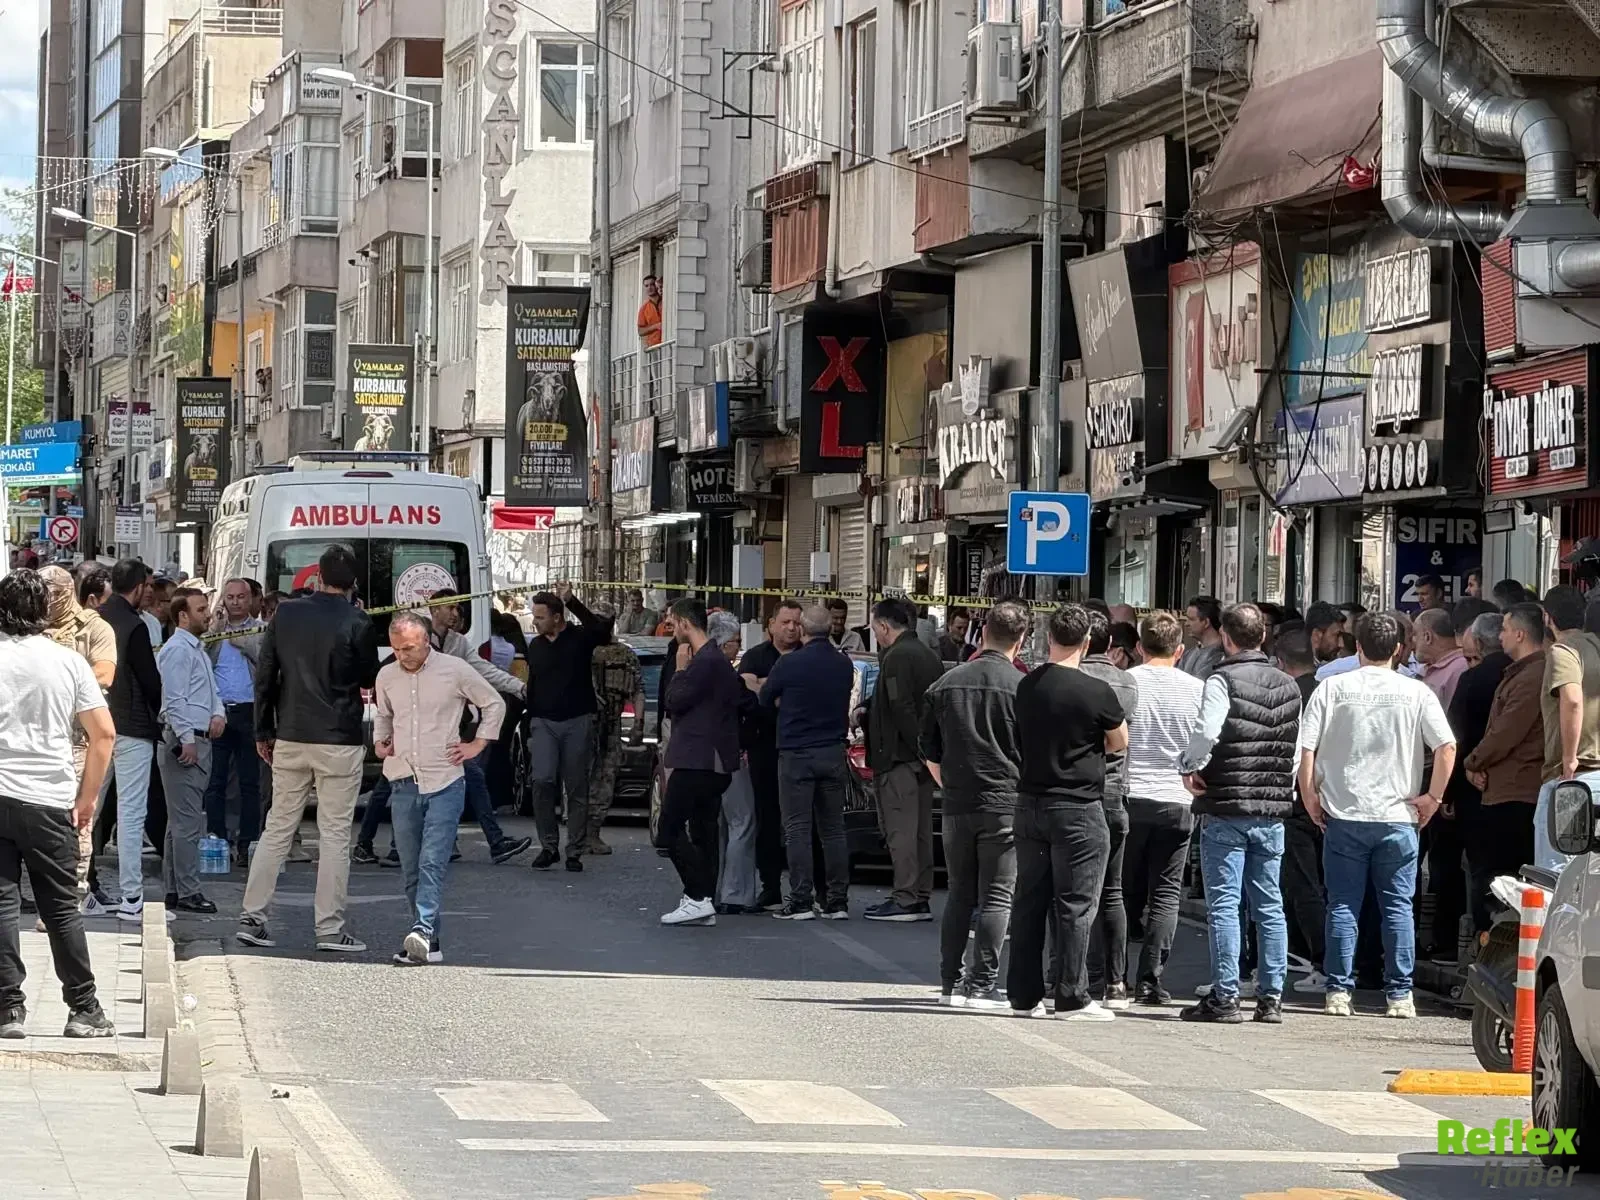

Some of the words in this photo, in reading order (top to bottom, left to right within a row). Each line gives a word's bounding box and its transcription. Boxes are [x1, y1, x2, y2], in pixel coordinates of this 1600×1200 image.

[525, 308, 578, 317] YAMANLAR
[514, 328, 580, 345] KURBANLIK
[362, 363, 405, 371] YAMANLAR
[353, 378, 407, 394] KURBANLIK
[1494, 389, 1529, 458] DİYAR
[1533, 379, 1575, 451] DÖNER
[24, 426, 58, 441] KUMYOL
[0, 461, 36, 473] SOKAĞI
[690, 467, 736, 492] HOTE
[290, 505, 441, 527] AMBULANS
[1398, 516, 1477, 544] SIFIR
[1430, 550, 1444, 565] &
